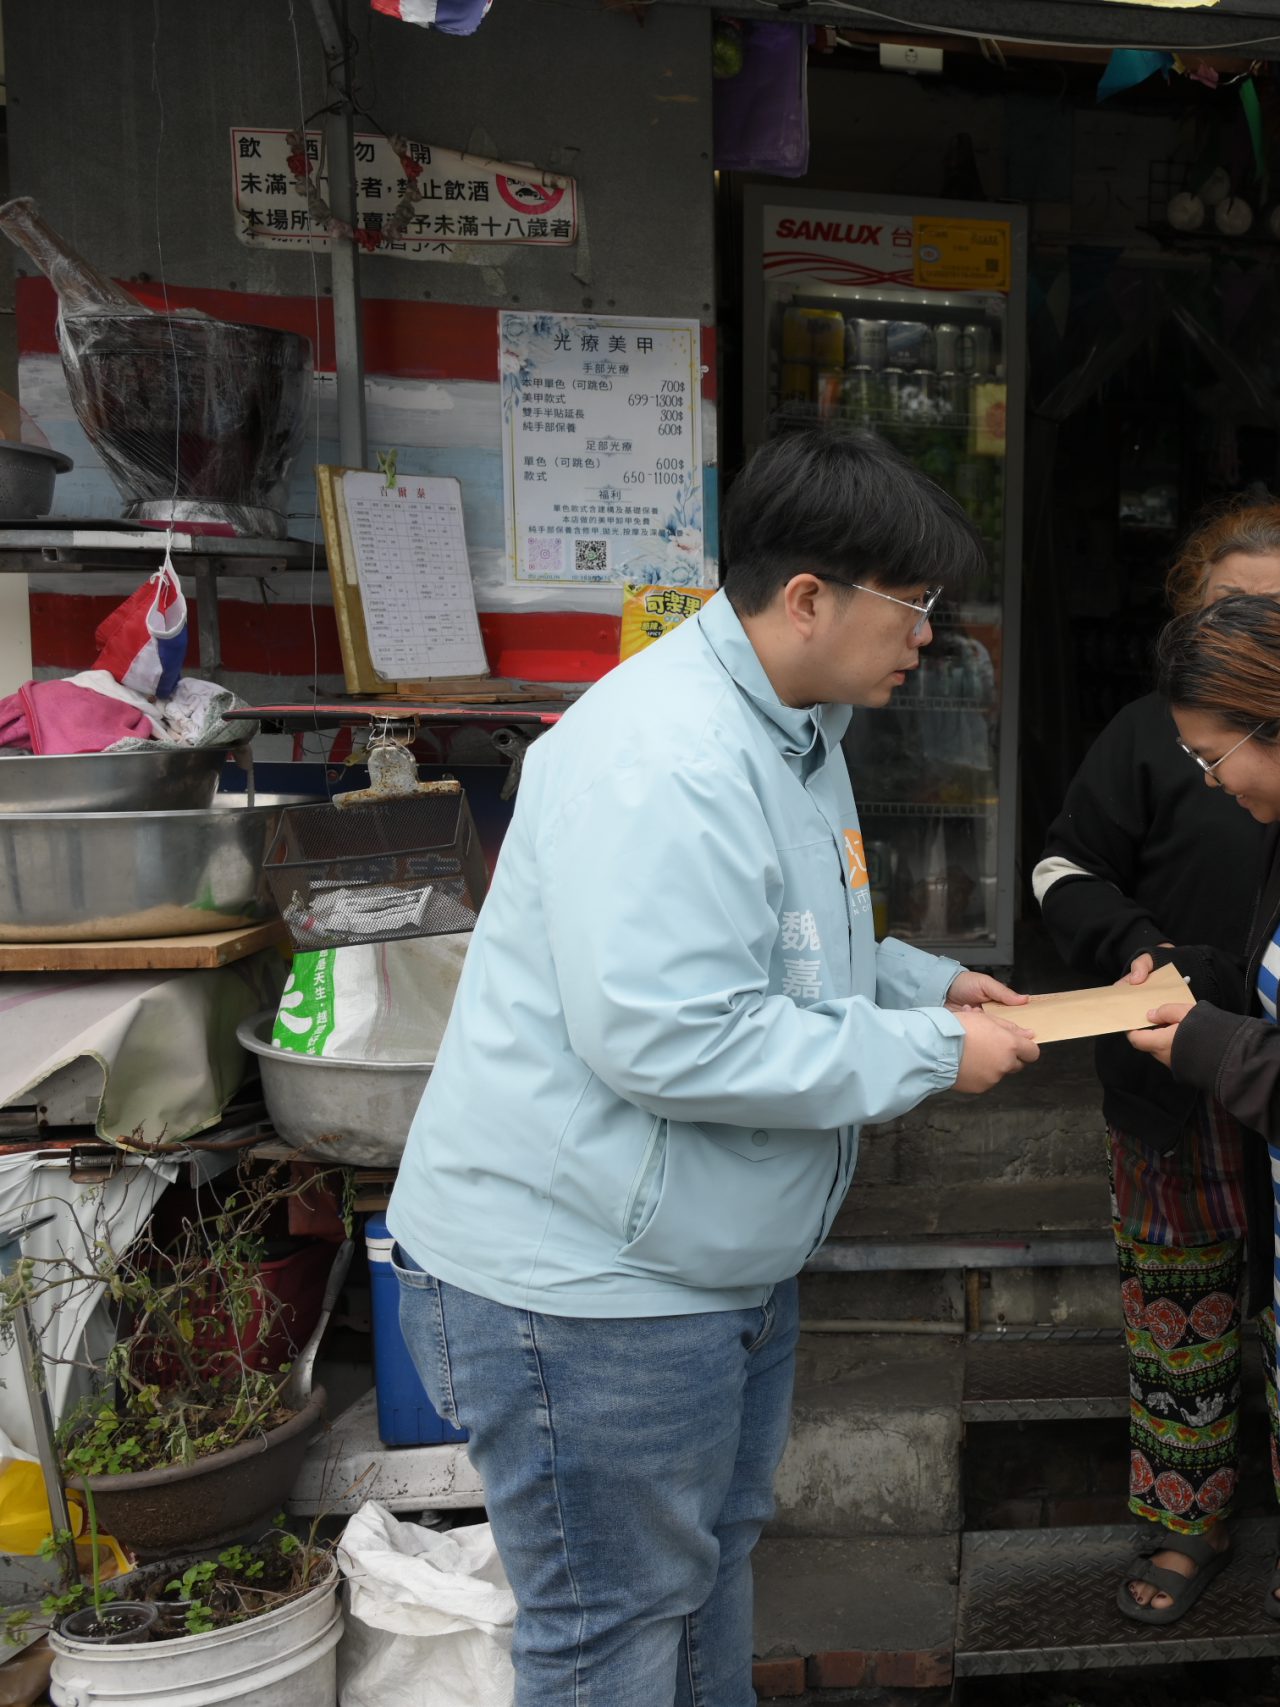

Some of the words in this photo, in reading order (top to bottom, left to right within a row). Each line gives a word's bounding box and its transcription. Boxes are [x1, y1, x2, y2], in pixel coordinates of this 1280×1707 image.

[776, 218, 884, 246] SANLUX
[553, 334, 654, 355] 光療美甲
[583, 362, 630, 375] 手部光療
[660, 379, 686, 393] 700$
[521, 393, 567, 404] 美甲款式
[660, 409, 684, 422] 300$
[522, 422, 576, 433] 純手部保養
[657, 423, 683, 436] 600$
[586, 440, 632, 452] 足部光療
[656, 457, 685, 470] 600$
[523, 471, 548, 482] 款式
[598, 490, 622, 500] 福利
[781, 908, 823, 1001] 魏嘉
